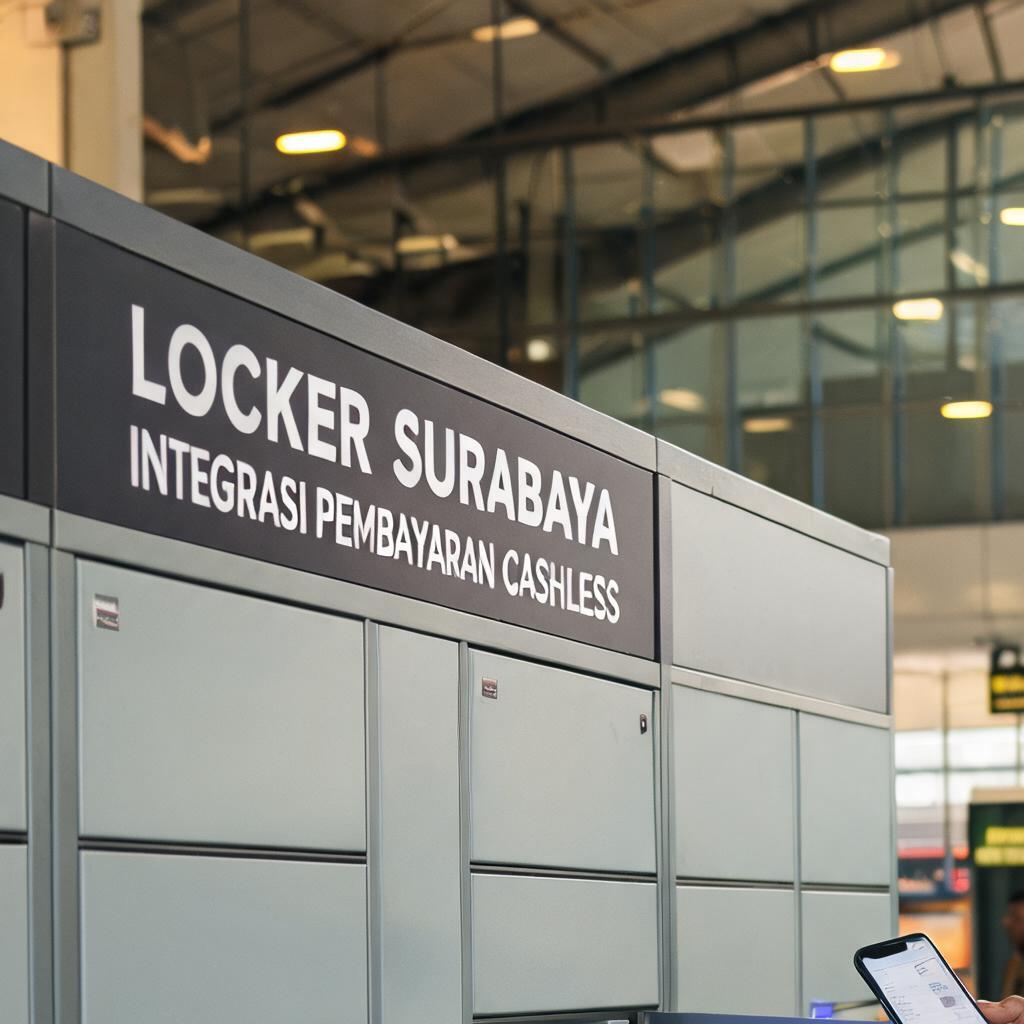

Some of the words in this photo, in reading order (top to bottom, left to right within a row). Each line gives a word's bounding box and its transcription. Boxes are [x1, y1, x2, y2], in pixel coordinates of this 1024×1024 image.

[130, 424, 308, 534] INTEGRASI
[316, 486, 495, 589] PEMBAYARAN
[502, 549, 620, 624] CASHLESS
[131, 304, 373, 475] LOCKER
[393, 408, 619, 556] SURABAYA
